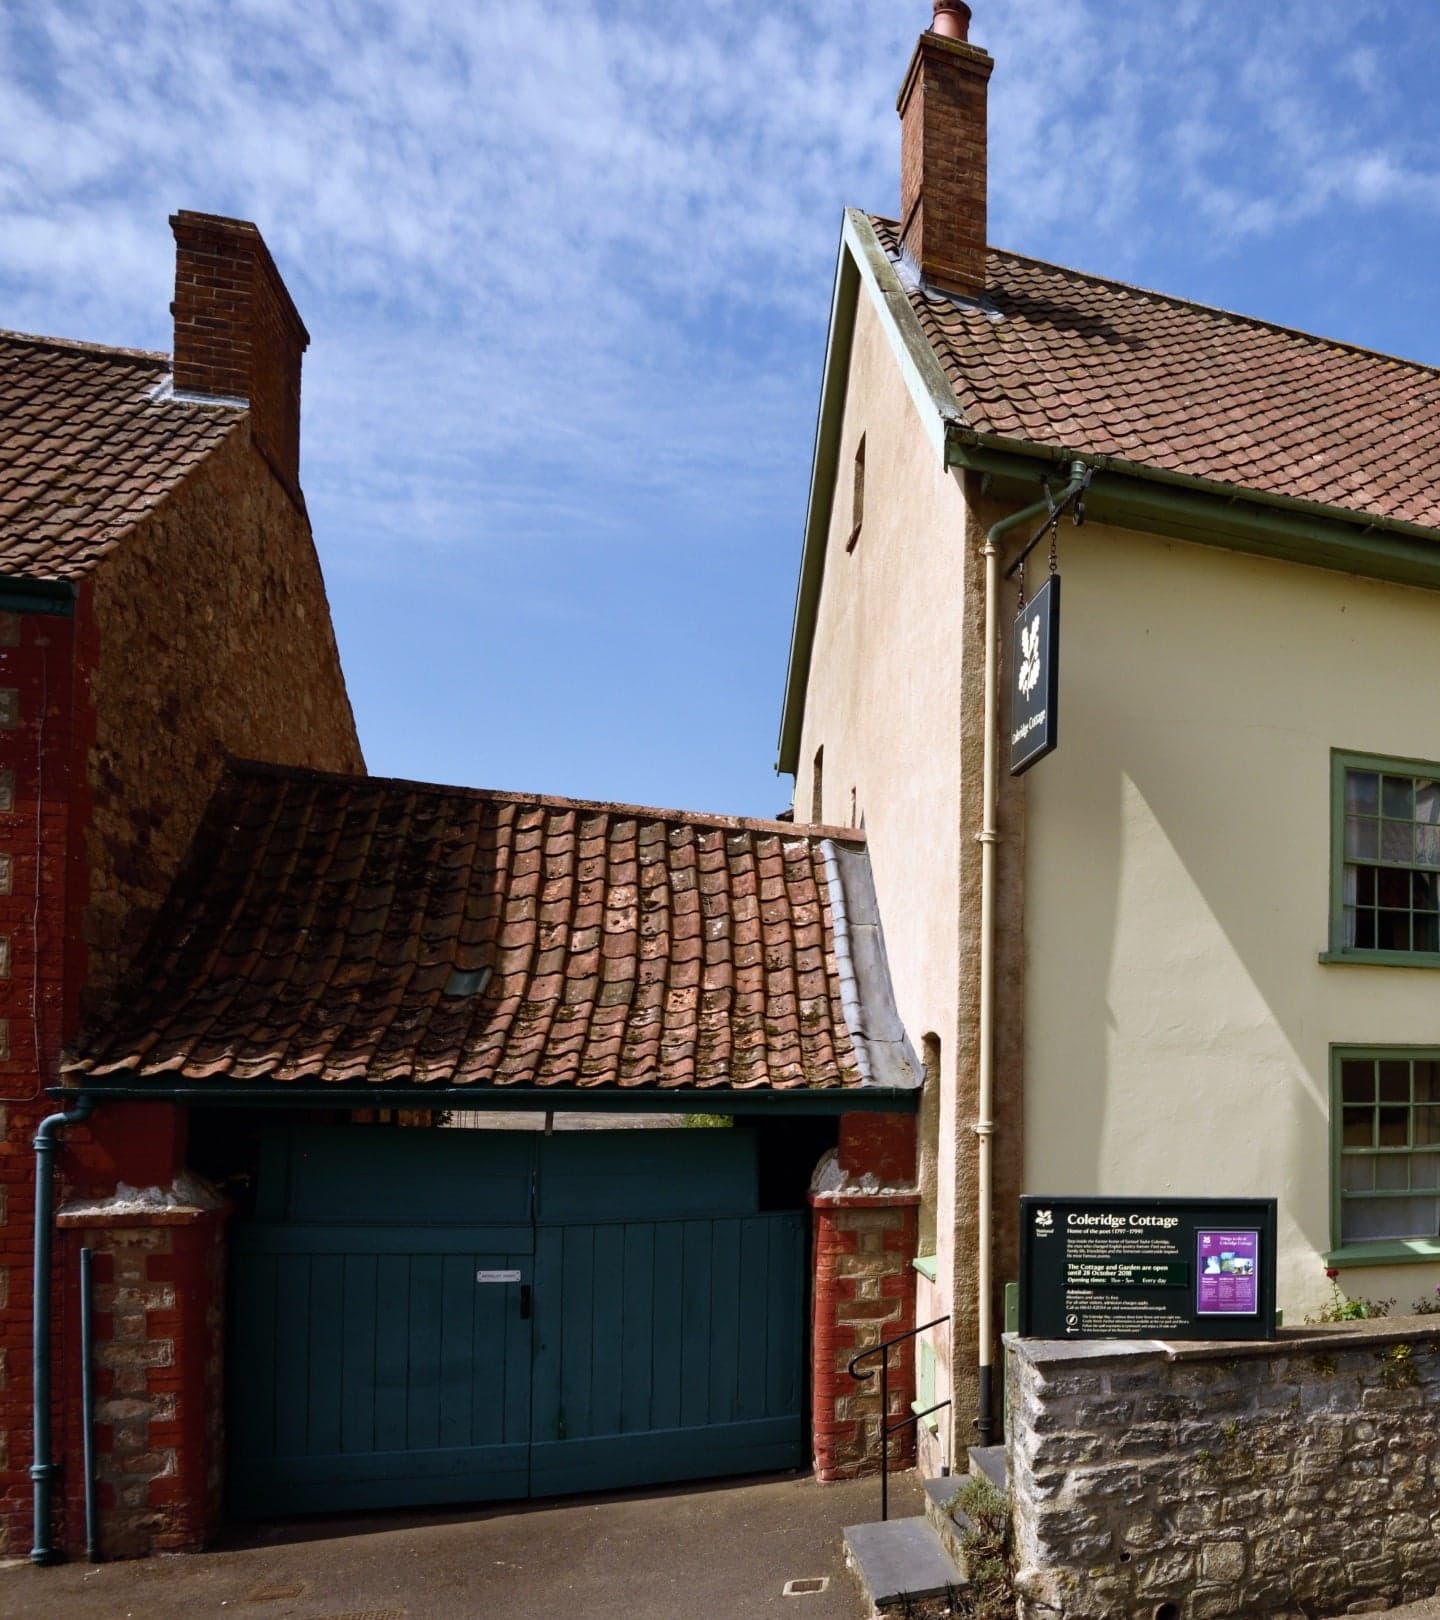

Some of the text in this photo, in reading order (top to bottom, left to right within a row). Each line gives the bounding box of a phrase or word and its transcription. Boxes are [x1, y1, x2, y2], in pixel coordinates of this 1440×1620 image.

[1028, 709, 1046, 730] Cottage
[1067, 1214, 1179, 1229] Coleridge Cottage
[1079, 1264, 1104, 1272] Cottage
